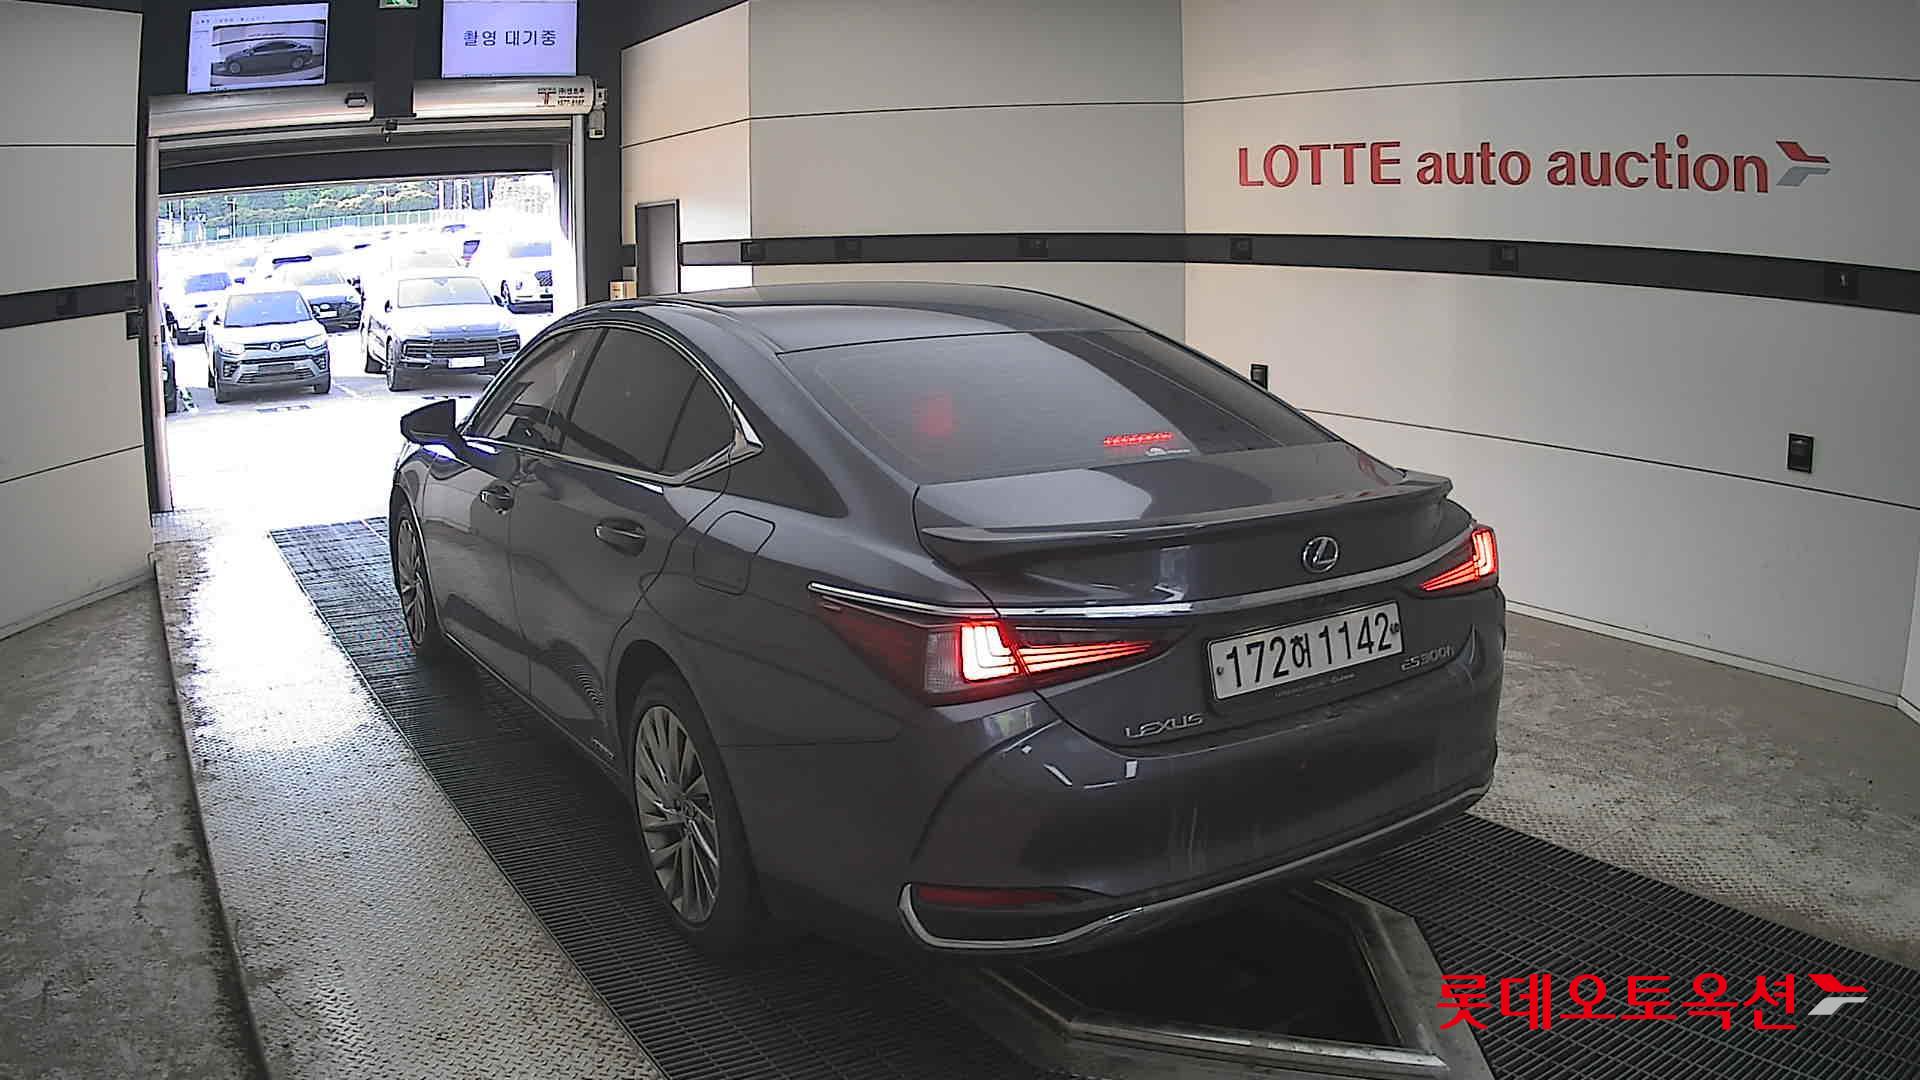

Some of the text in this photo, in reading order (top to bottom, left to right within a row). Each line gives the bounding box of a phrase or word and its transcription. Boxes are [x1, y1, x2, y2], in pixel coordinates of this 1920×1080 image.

[464, 30, 556, 47] 촬영 대기중
[1239, 133, 1768, 193] LOTTE auto auction
[1125, 713, 1203, 738] LEXUS
